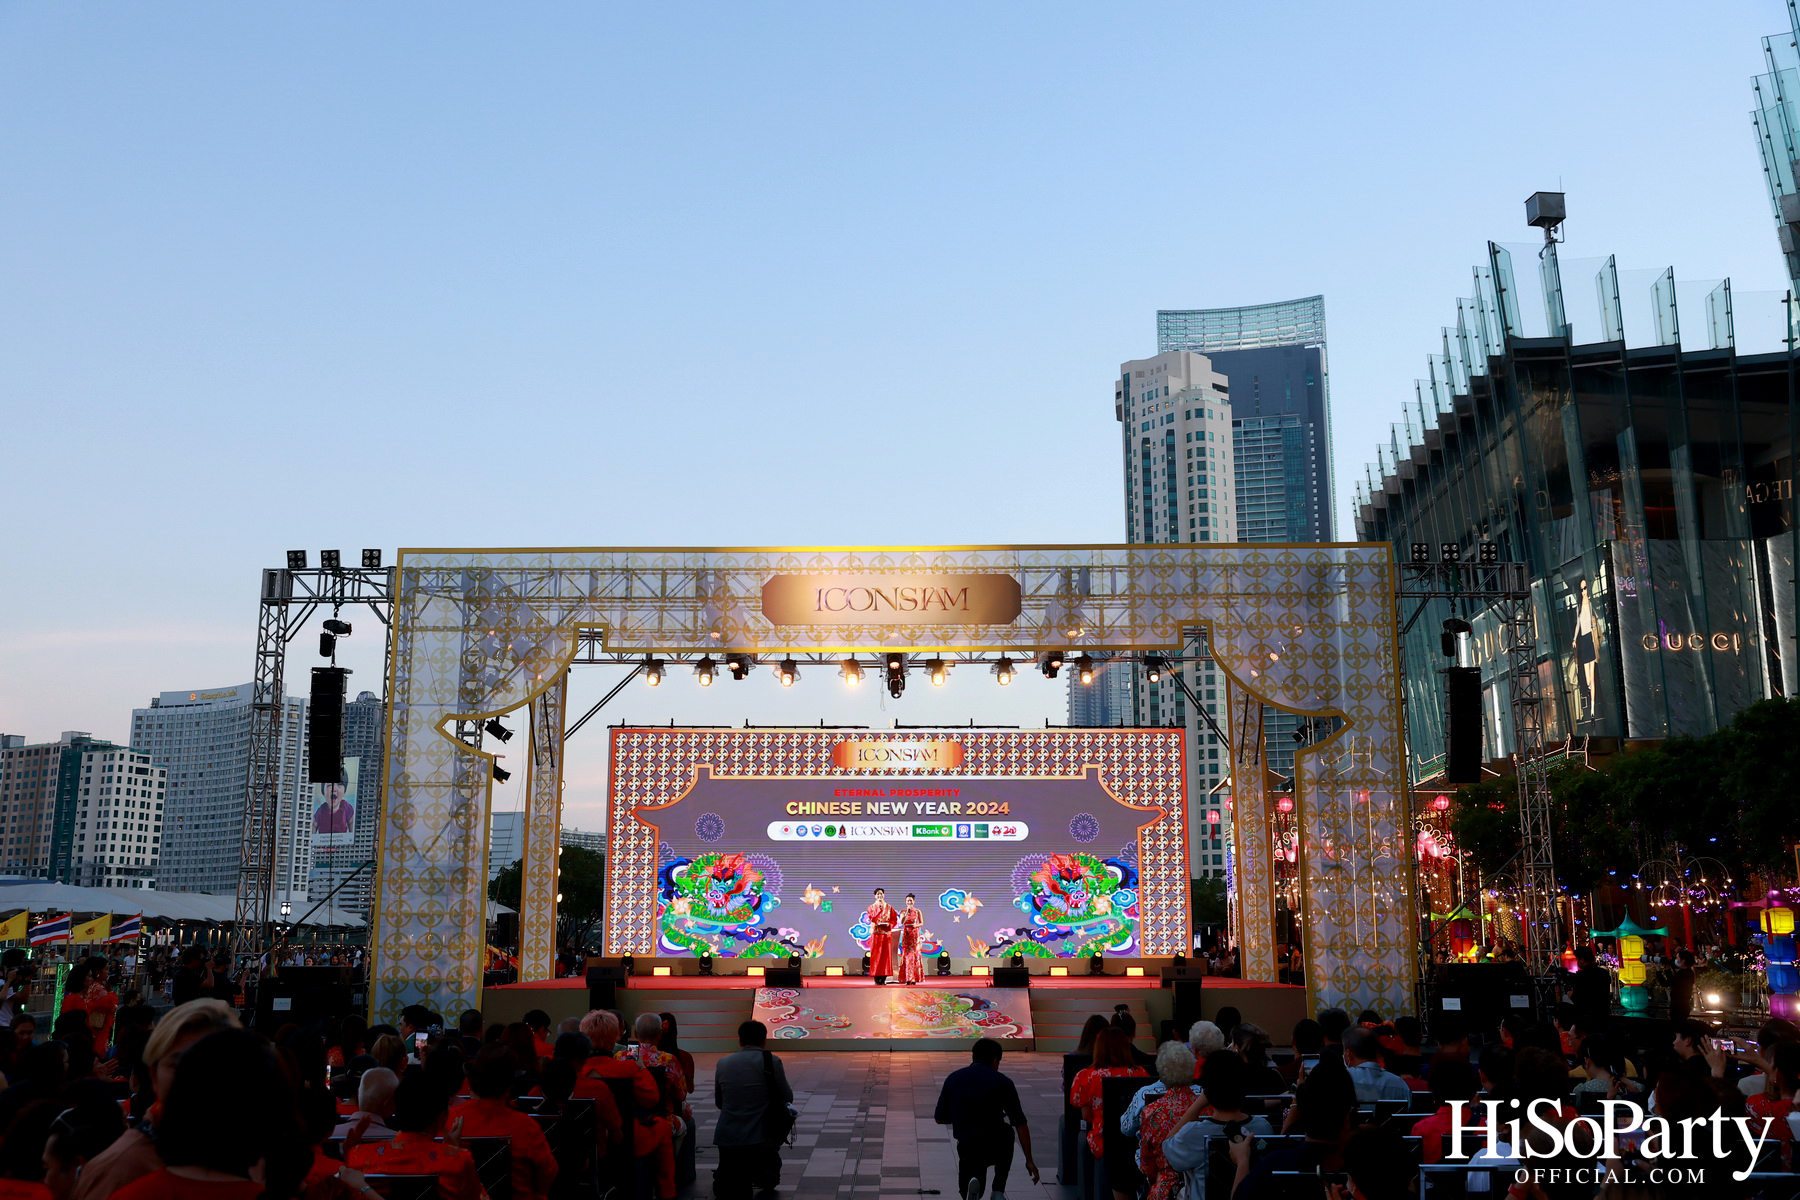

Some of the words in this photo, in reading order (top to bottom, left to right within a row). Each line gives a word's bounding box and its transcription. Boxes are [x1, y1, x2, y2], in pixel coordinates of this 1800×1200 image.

[814, 587, 970, 612] ICONSIAM
[1642, 632, 1741, 651] GUCCI
[858, 748, 939, 762] ICONSIAM
[834, 789, 886, 797] ETERNAL
[890, 789, 961, 797] PROSPERITY
[786, 801, 862, 815] CHINESE
[866, 801, 910, 815] NEW
[913, 801, 961, 815] YEAR
[966, 801, 1010, 815] 2024
[851, 826, 909, 836] ICONSIAM
[916, 827, 939, 835] KBank
